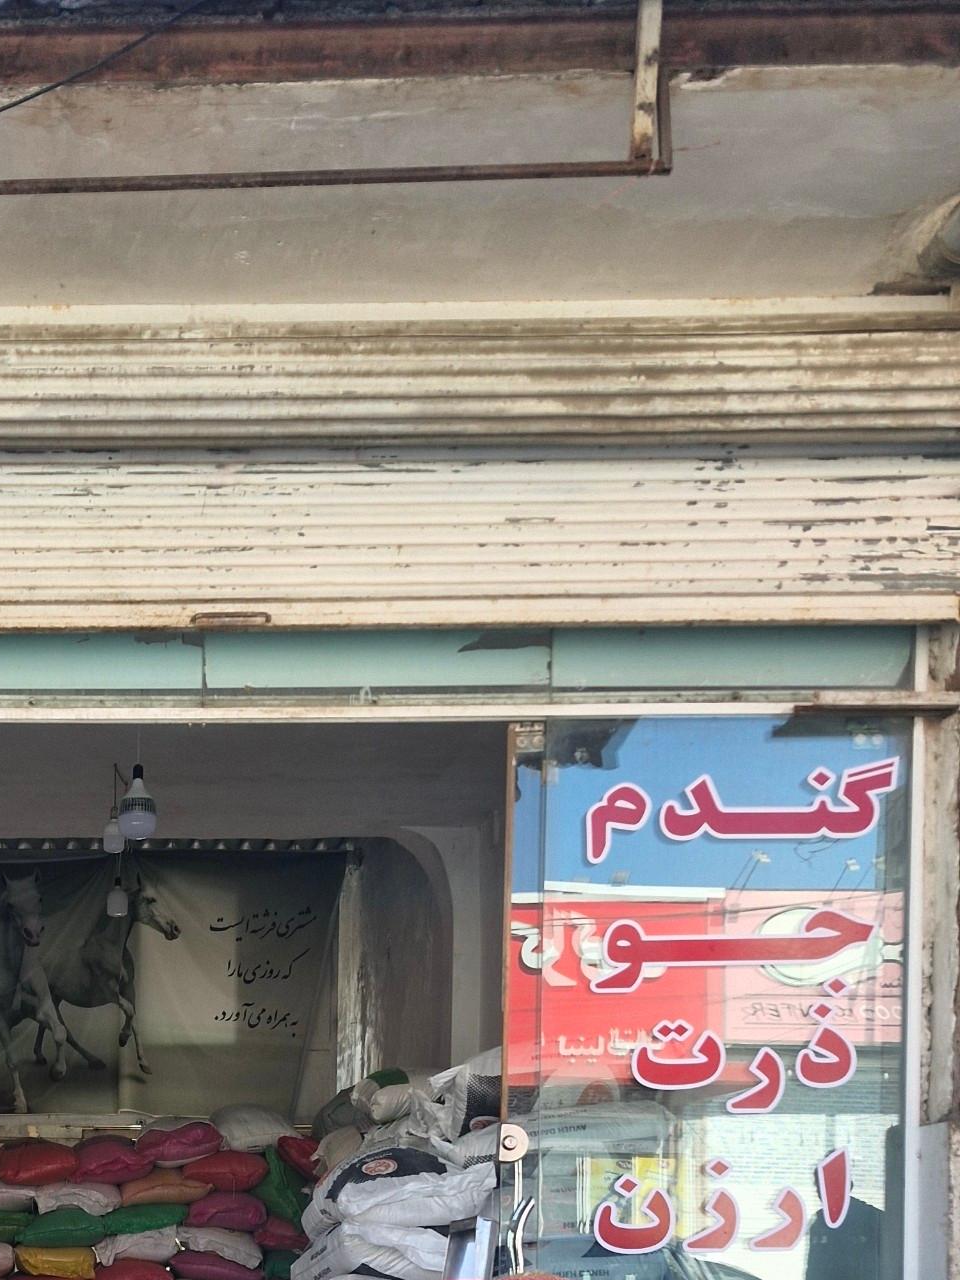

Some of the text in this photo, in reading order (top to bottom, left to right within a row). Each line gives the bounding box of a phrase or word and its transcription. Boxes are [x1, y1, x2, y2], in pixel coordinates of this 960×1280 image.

[584, 754, 900, 864] گندم
[588, 905, 880, 999] جو
[630, 998, 858, 1114] ذرت
[593, 1145, 853, 1254] ارزن
